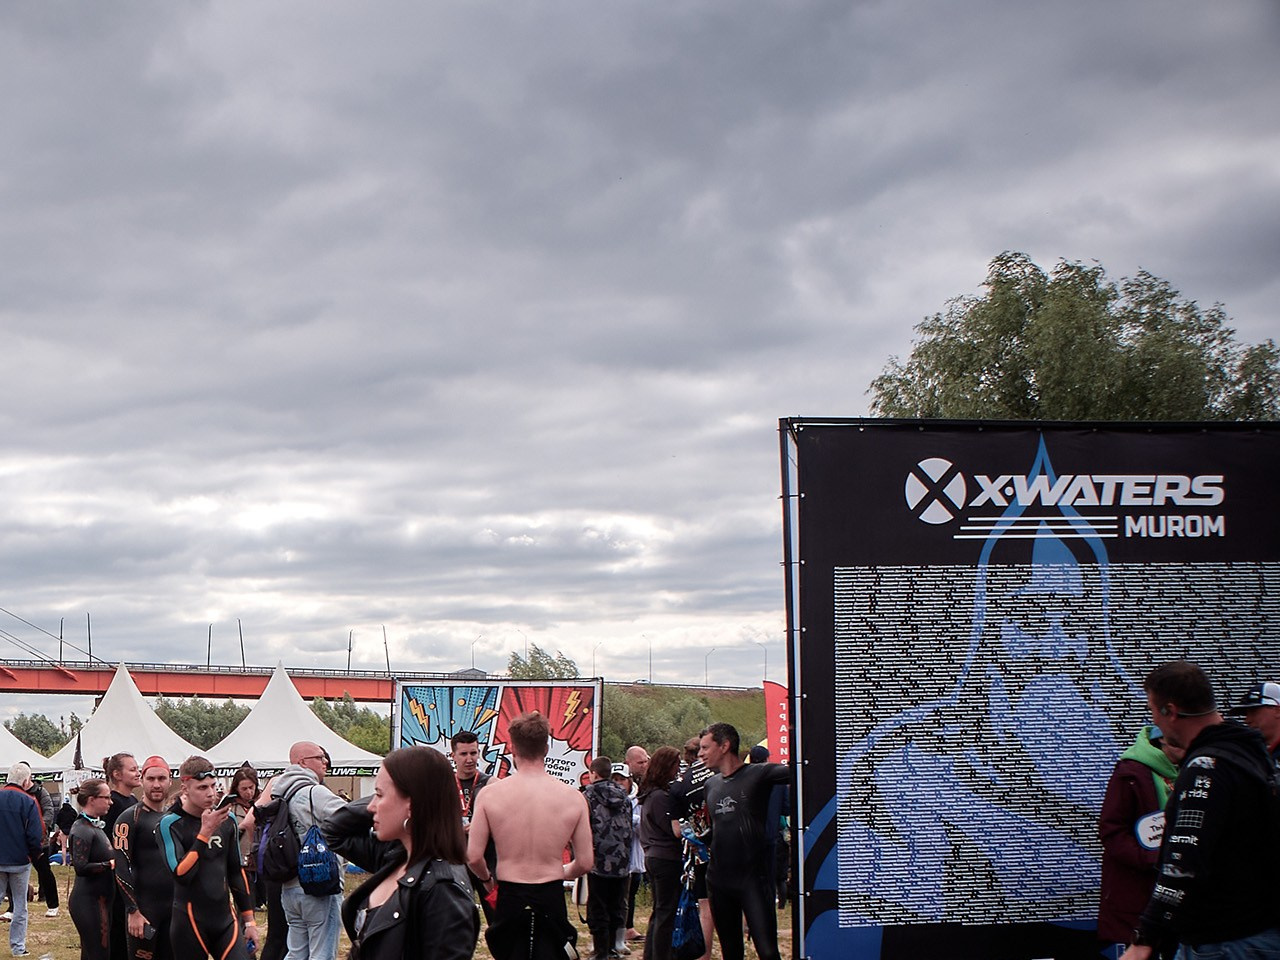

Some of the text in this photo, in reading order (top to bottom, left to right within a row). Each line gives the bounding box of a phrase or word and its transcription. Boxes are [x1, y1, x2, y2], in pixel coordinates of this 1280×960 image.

[1125, 515, 1225, 538] MUROM
[544, 757, 577, 767] рутого
[217, 769, 238, 778] UW
[332, 767, 357, 776] UWS
